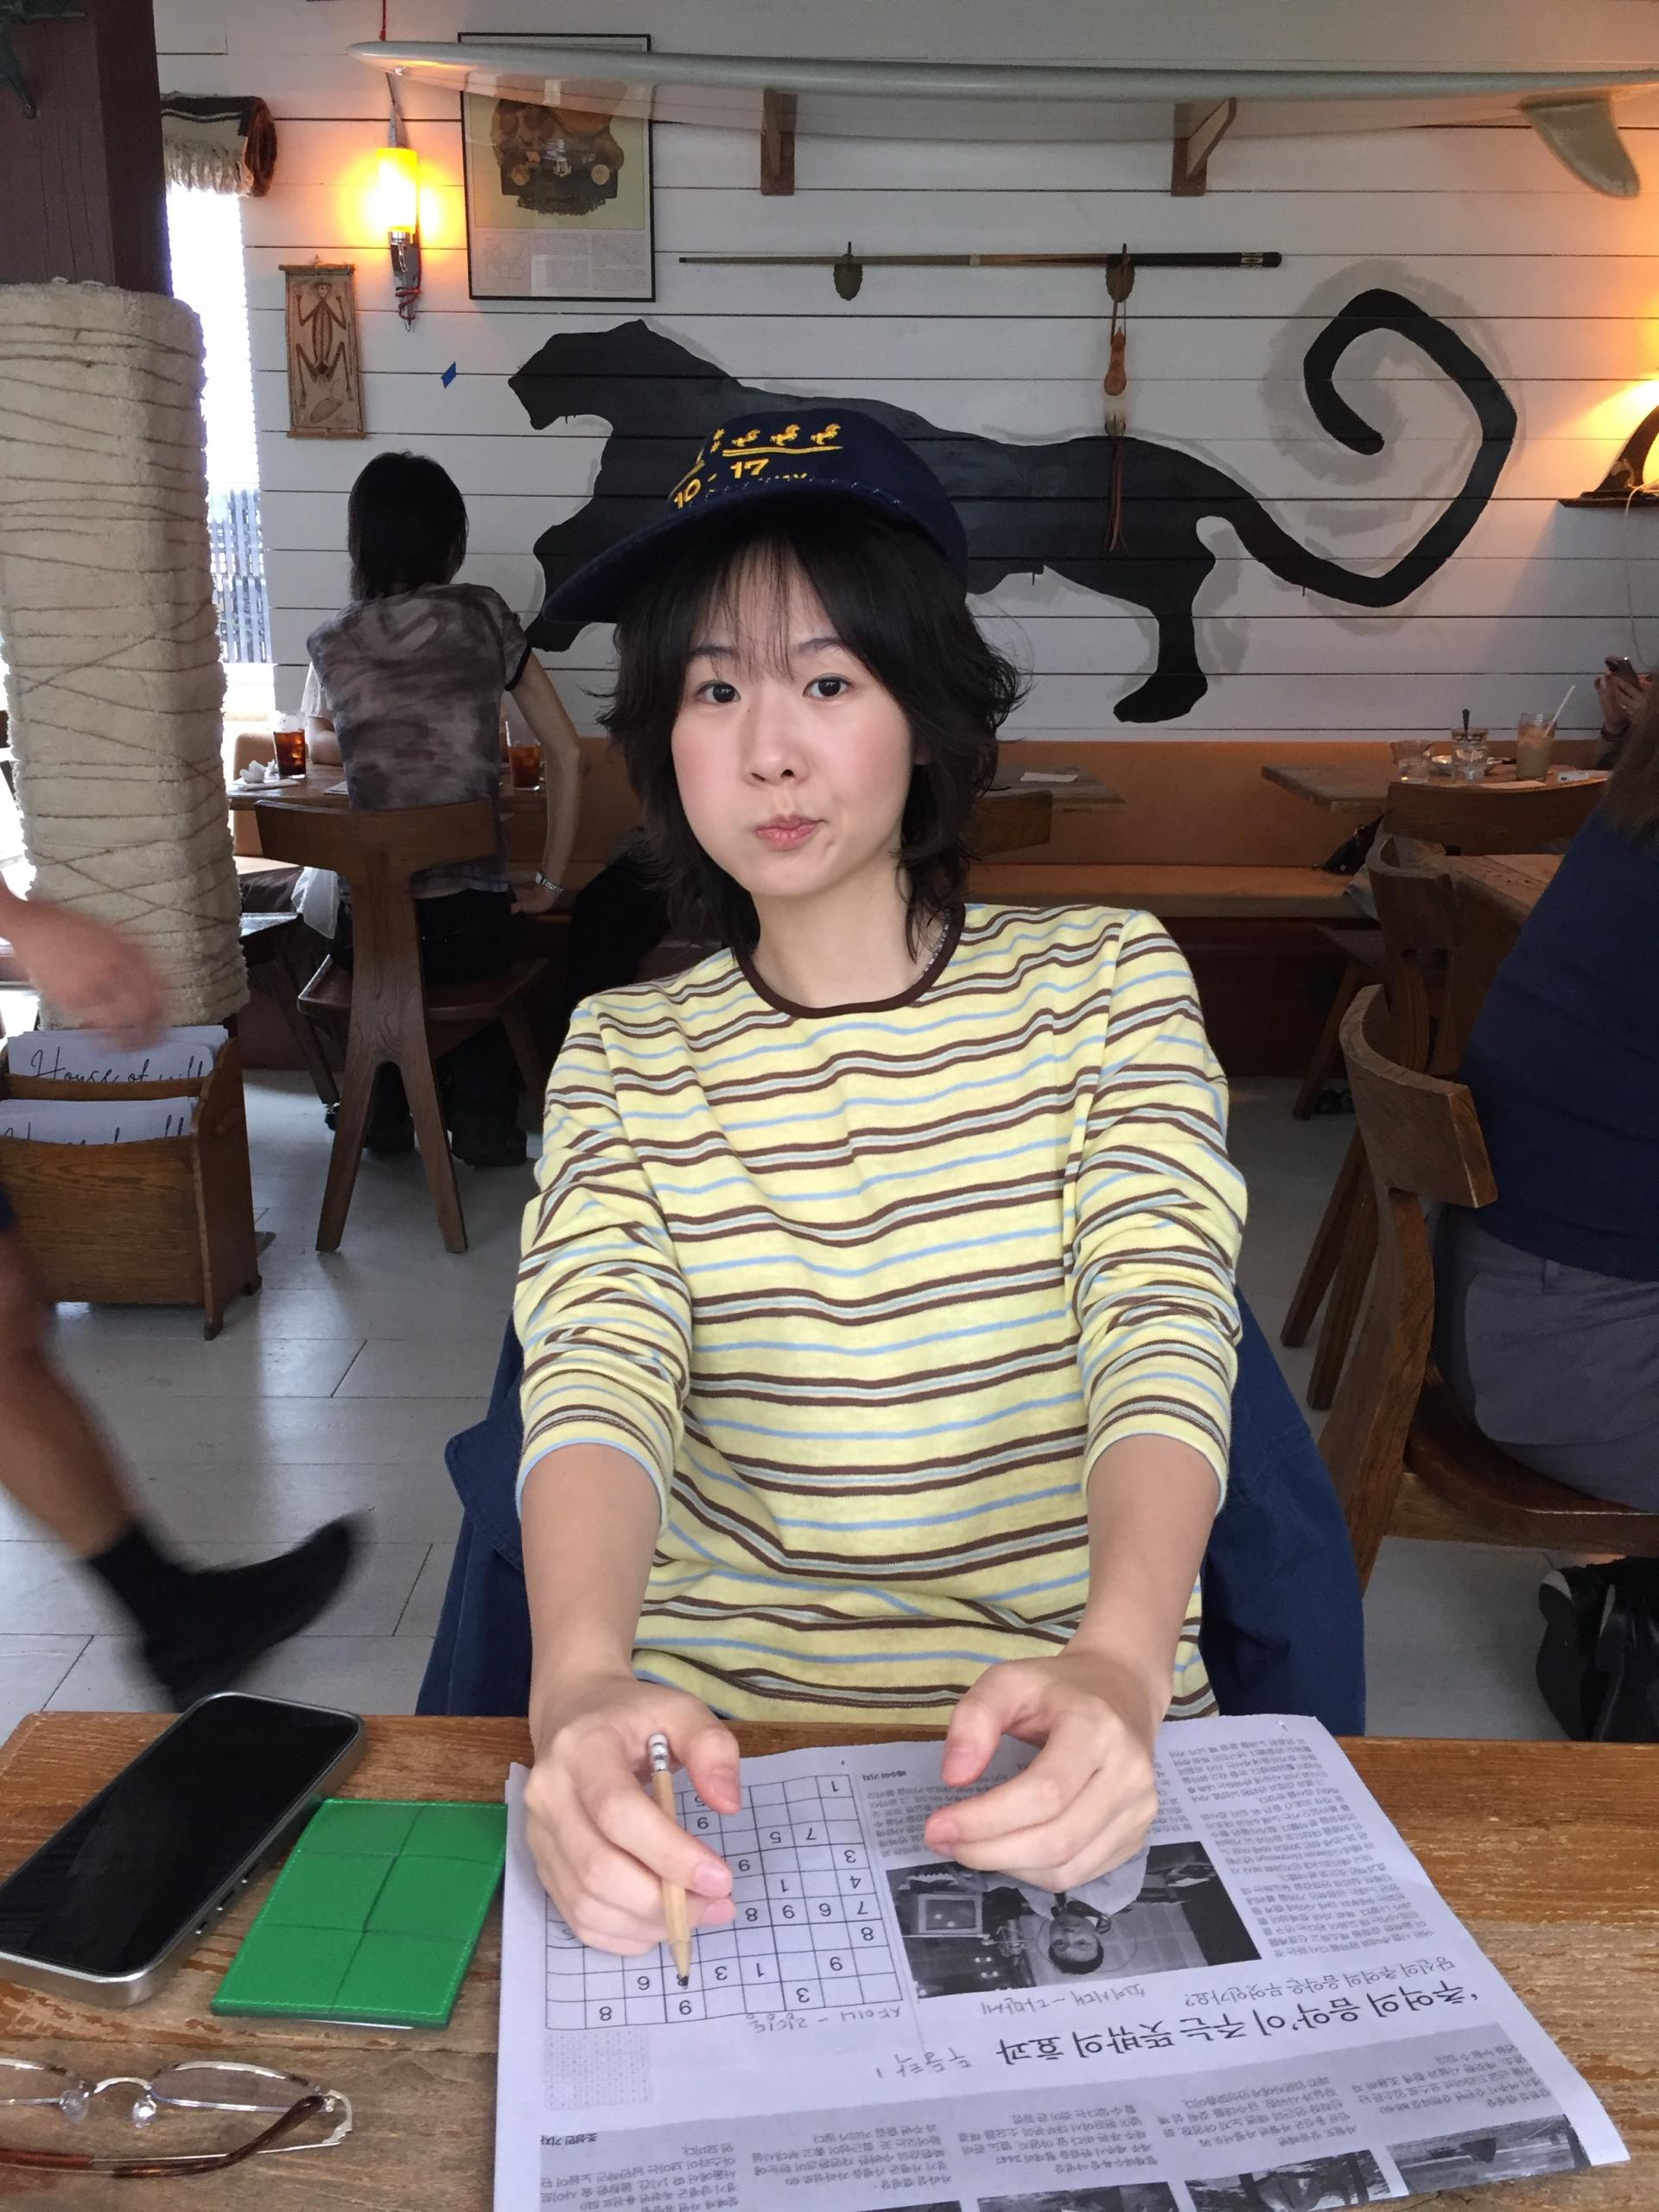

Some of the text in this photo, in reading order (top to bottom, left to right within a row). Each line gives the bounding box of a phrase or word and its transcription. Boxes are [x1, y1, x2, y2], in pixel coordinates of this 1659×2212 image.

[730, 458, 769, 480] 17
[674, 478, 702, 509] 10
[830, 1780, 839, 1793] 1
[862, 1773, 879, 1782] 기자
[696, 1816, 709, 1830] 9
[769, 1827, 817, 1845] 7 5
[737, 1848, 857, 1872] 3 9
[779, 1875, 862, 1893] 4 1
[744, 1900, 869, 1923] 7 6 9 8
[860, 1926, 874, 1942] 8
[636, 1955, 843, 1991] 9 1 3 6
[1183, 1956, 1456, 2007] 당신의 추억의 음악은 무엇인가요?
[598, 1986, 810, 2022] 3 9 8
[840, 2006, 900, 2022] 샤이니
[1179, 2013, 1246, 2041] 주는
[1071, 2021, 1175, 2058] 뜻밖의
[996, 2037, 1065, 2065] 효과
[540, 2133, 597, 2145] 조성민 기자
